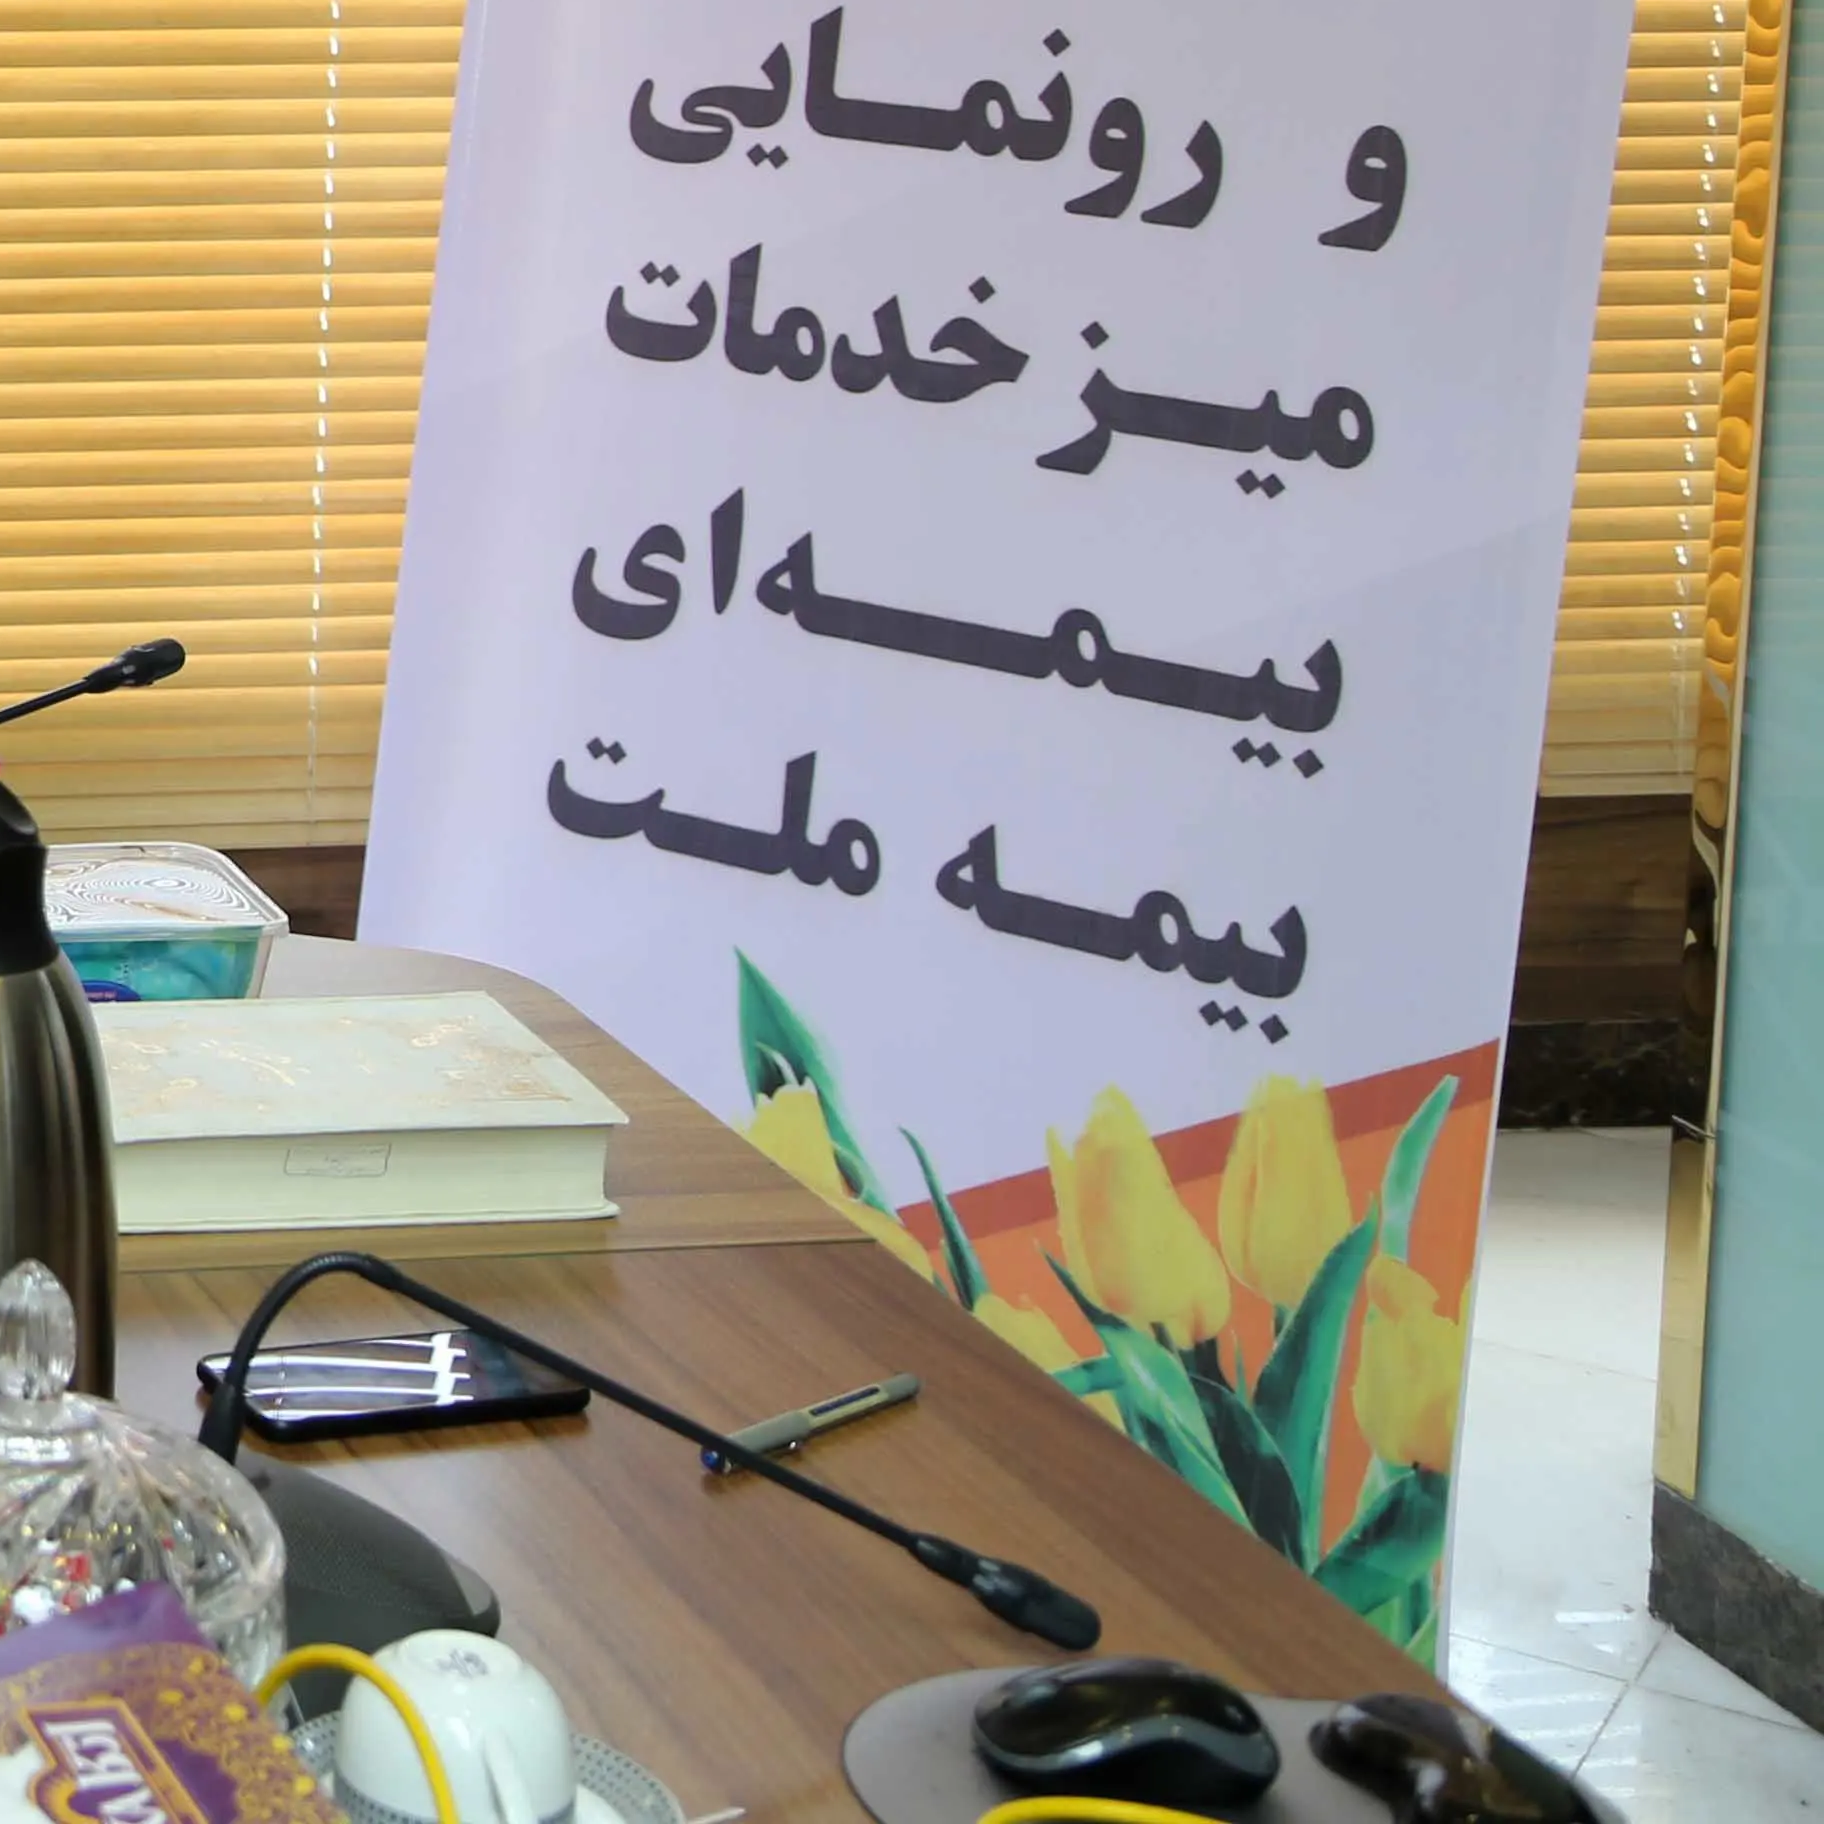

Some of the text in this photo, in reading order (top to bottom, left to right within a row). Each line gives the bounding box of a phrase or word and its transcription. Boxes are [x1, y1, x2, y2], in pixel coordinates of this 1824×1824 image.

[629, 6, 1408, 252] و رونمایی
[606, 243, 1375, 499] میز خدمات
[547, 737, 1308, 1045] بیمه ملت
